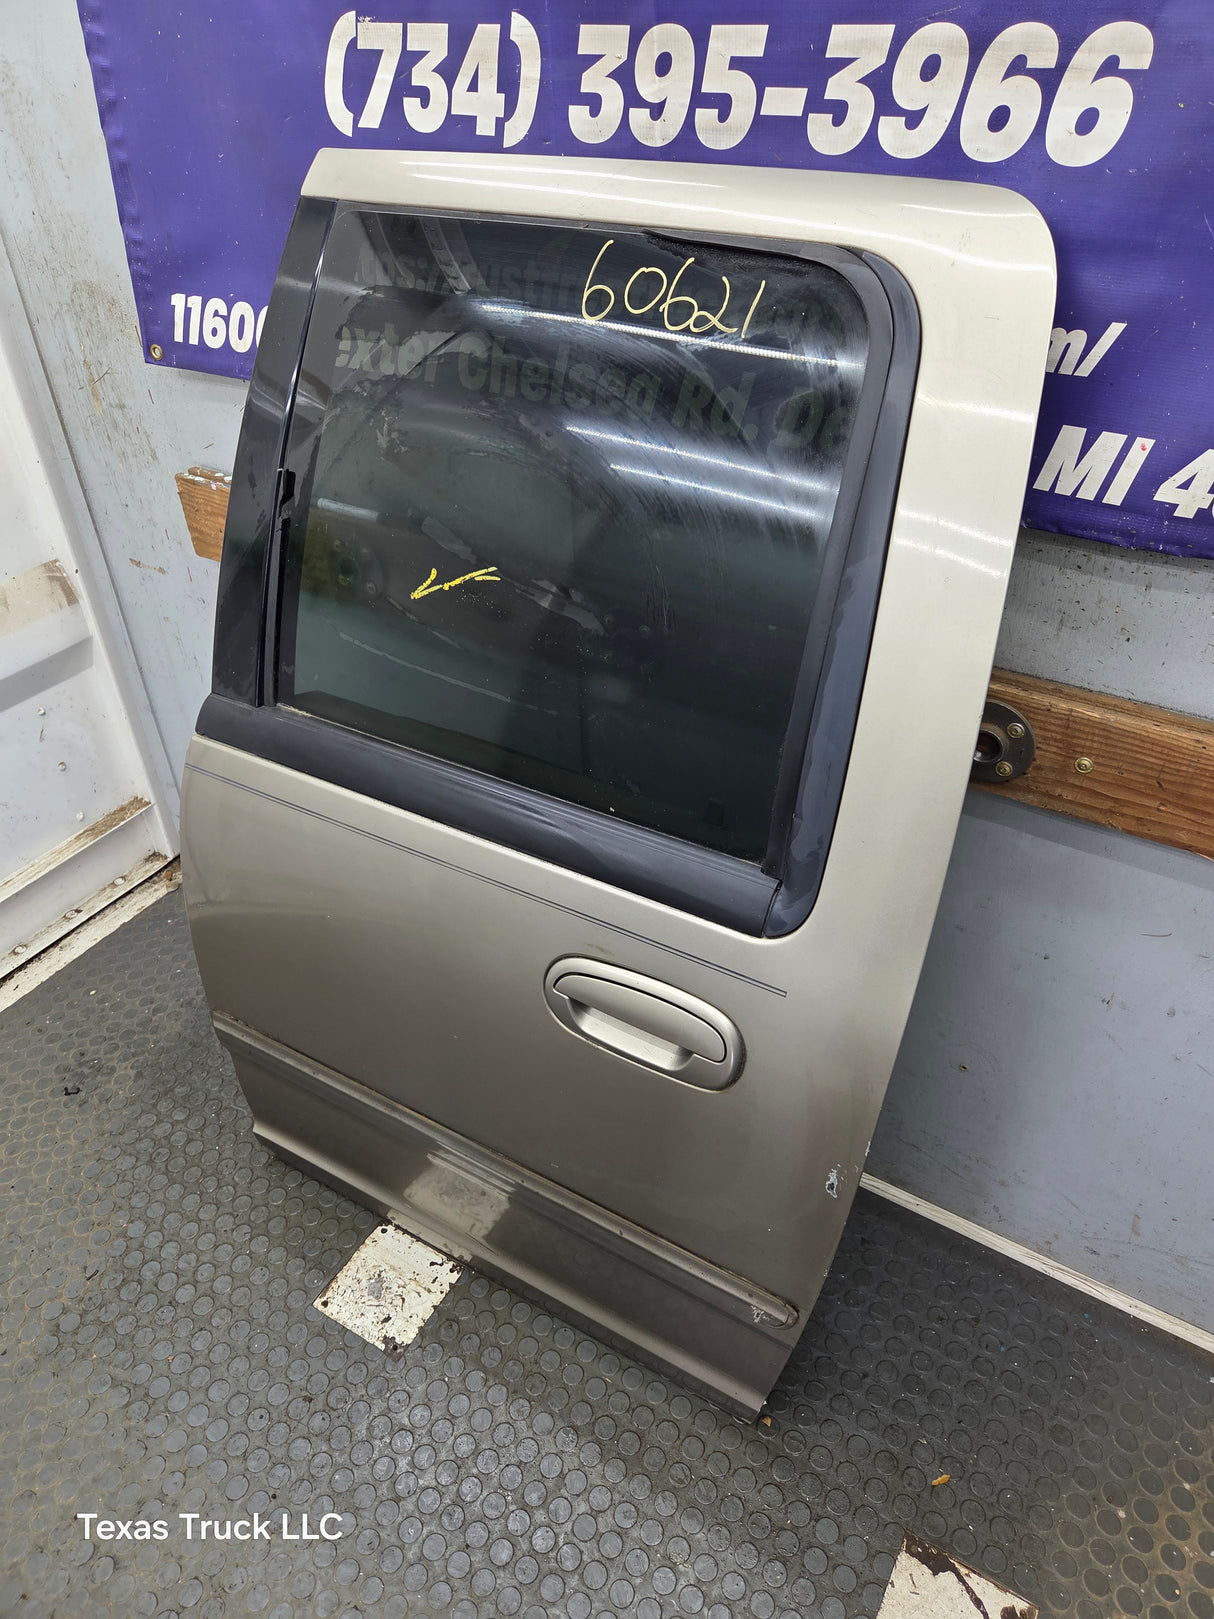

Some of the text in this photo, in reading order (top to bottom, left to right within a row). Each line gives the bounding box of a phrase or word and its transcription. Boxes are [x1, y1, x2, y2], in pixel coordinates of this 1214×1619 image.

[324, 10, 1154, 167] (734) 395-3966
[581, 239, 767, 339] 60621
[1032, 424, 1156, 507] MI
[1153, 448, 1214, 519] 4
